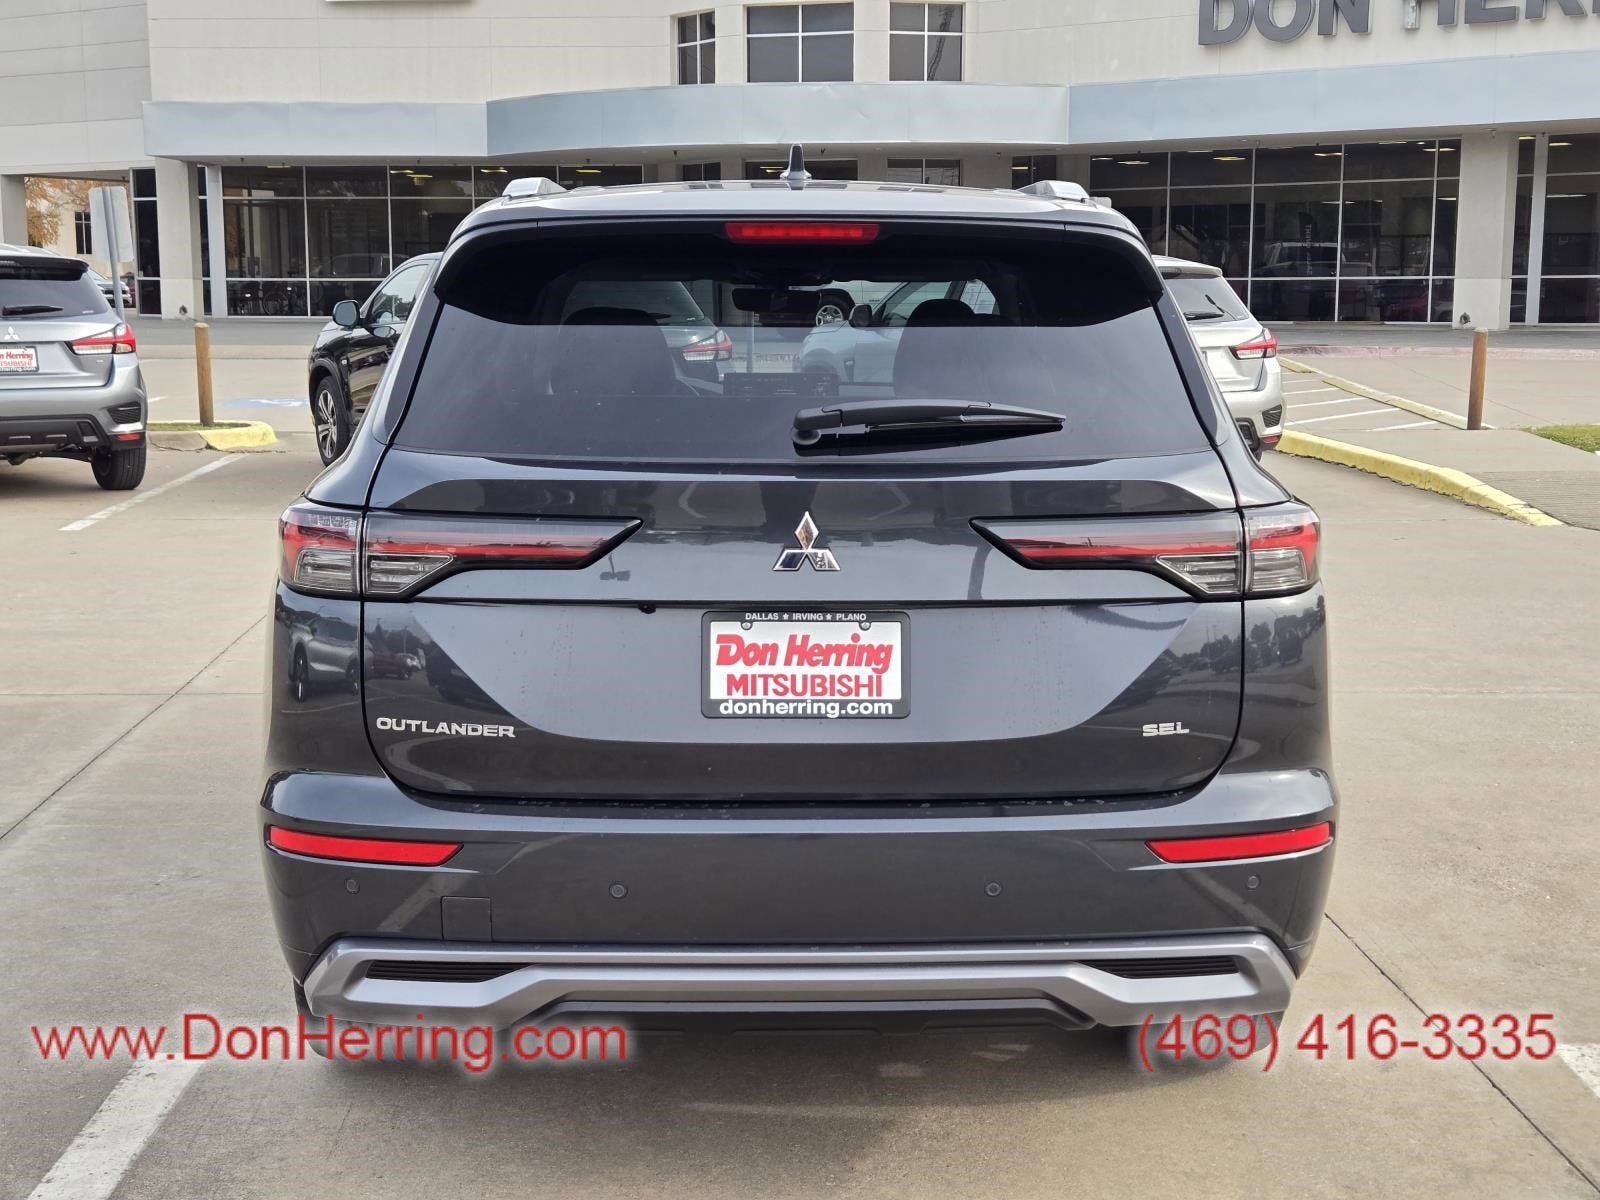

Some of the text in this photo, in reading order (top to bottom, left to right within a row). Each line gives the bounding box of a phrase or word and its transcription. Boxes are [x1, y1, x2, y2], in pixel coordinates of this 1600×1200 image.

[1198, 0, 1372, 45] DON
[792, 613, 824, 621] IRVING
[835, 613, 867, 621] PLANO
[716, 633, 893, 674] Don Herring
[727, 673, 883, 697] MITSUBISHI
[719, 700, 893, 718] donherring.com
[376, 717, 516, 738] OUTLANDER
[1142, 721, 1190, 737] SEL
